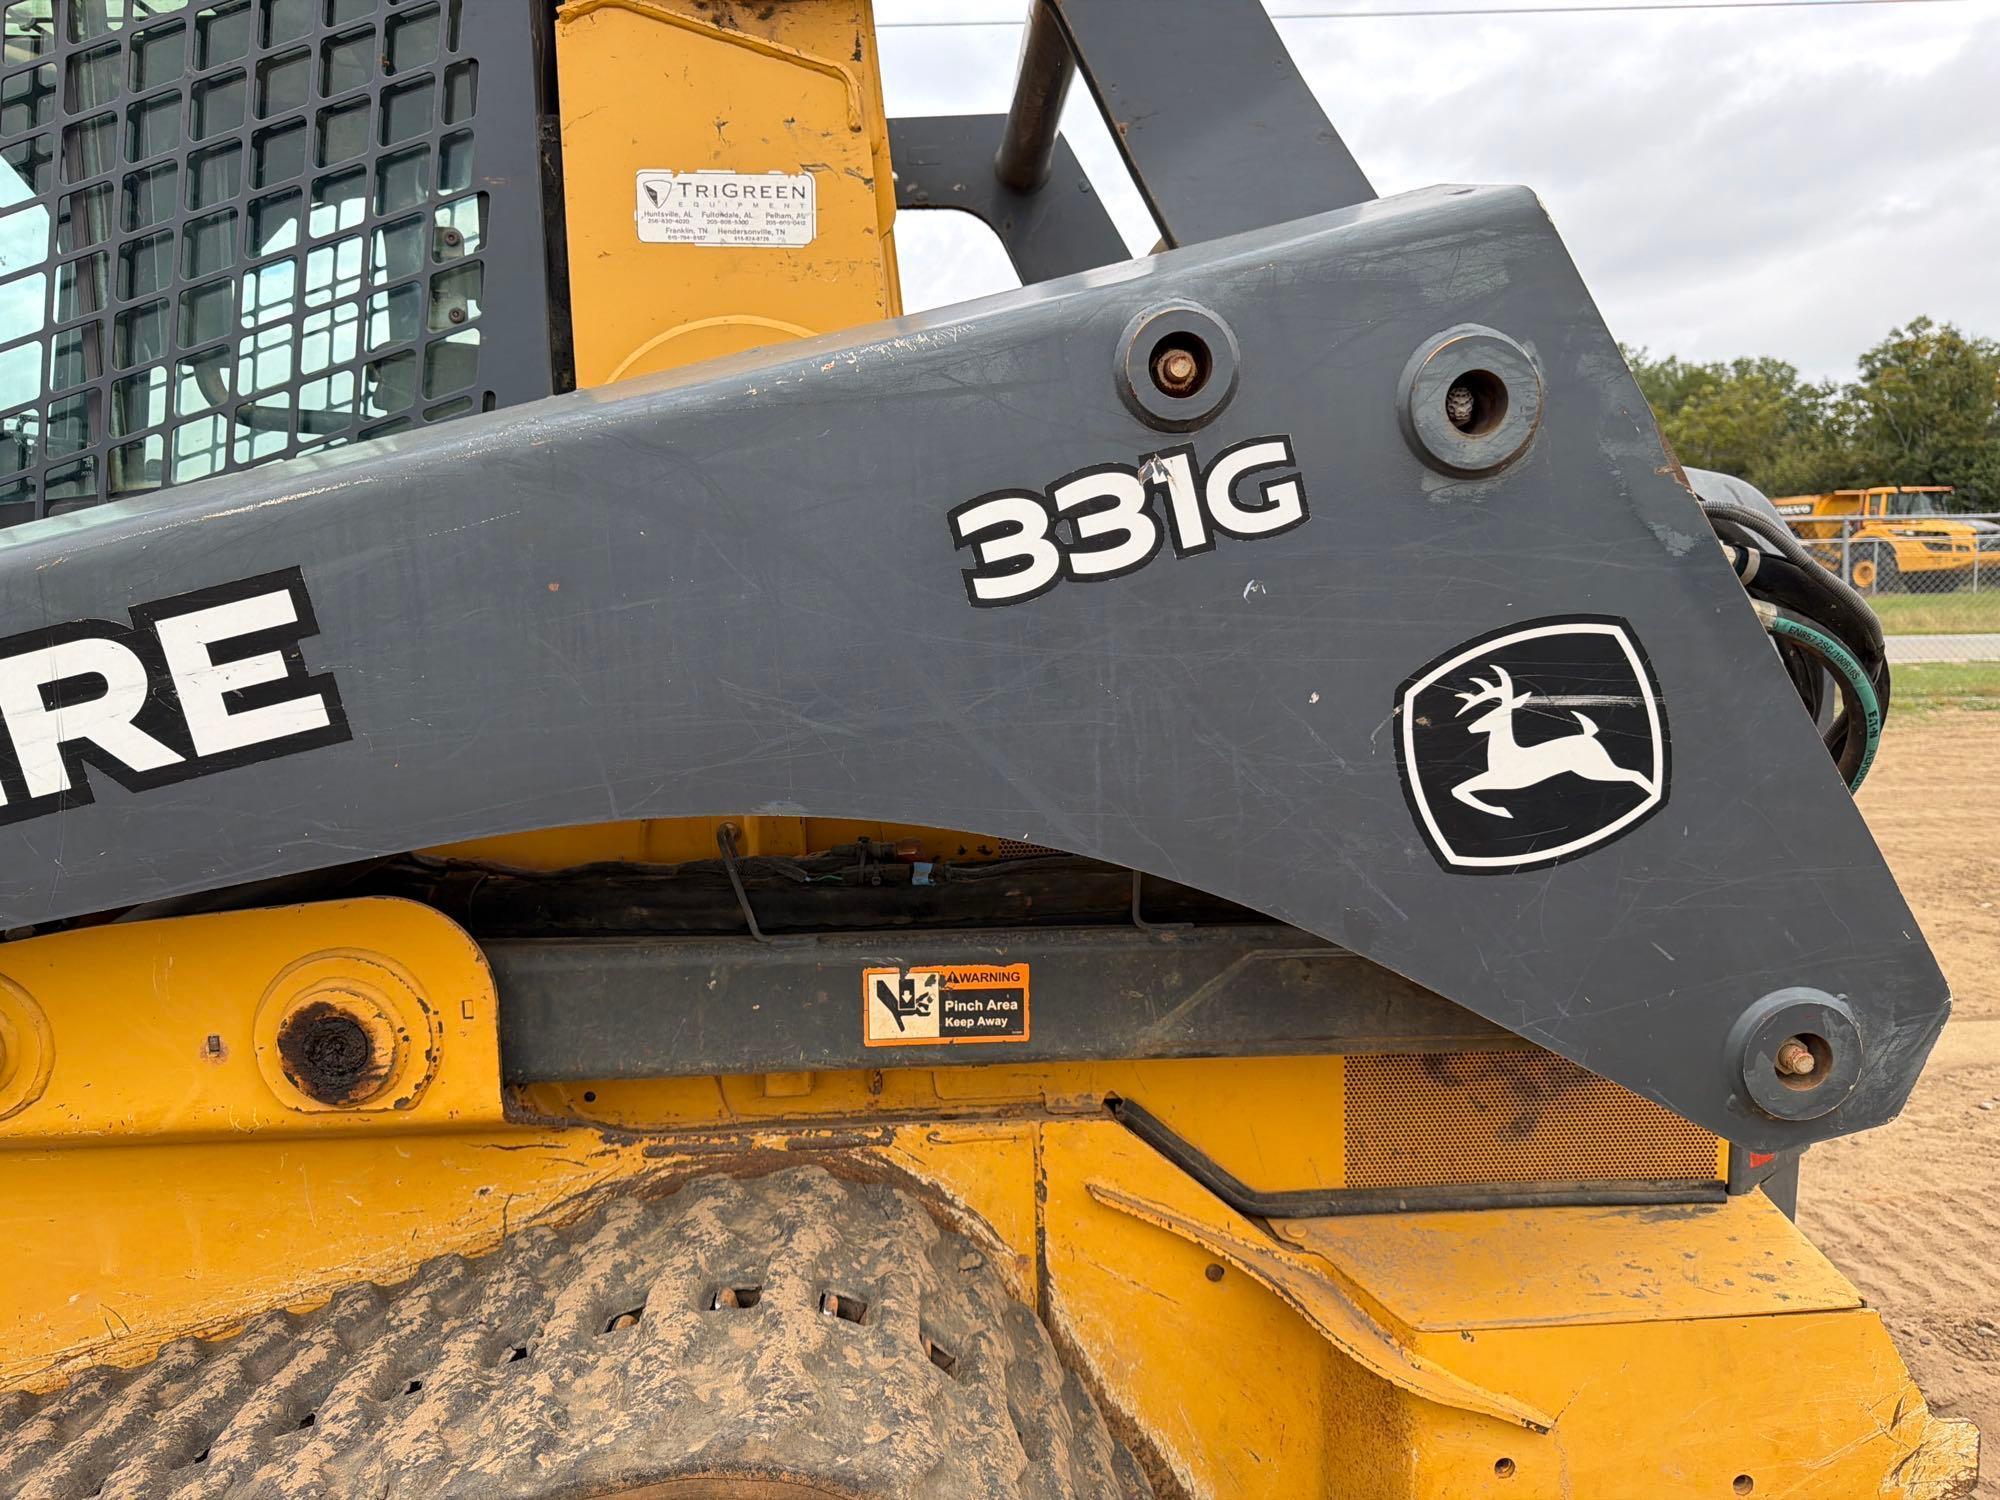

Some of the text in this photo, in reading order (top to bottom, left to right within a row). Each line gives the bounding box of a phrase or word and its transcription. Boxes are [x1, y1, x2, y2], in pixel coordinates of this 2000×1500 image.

[644, 211, 681, 219] Huntsville,
[665, 227, 696, 235] Franklin,
[717, 228, 774, 236] Hendersonville,
[956, 441, 1303, 600] 331G
[0, 588, 330, 807] RE
[960, 972, 1021, 983] WARNING
[944, 999, 1018, 1012] Pinch Area
[945, 1016, 1008, 1029] Keep Away
